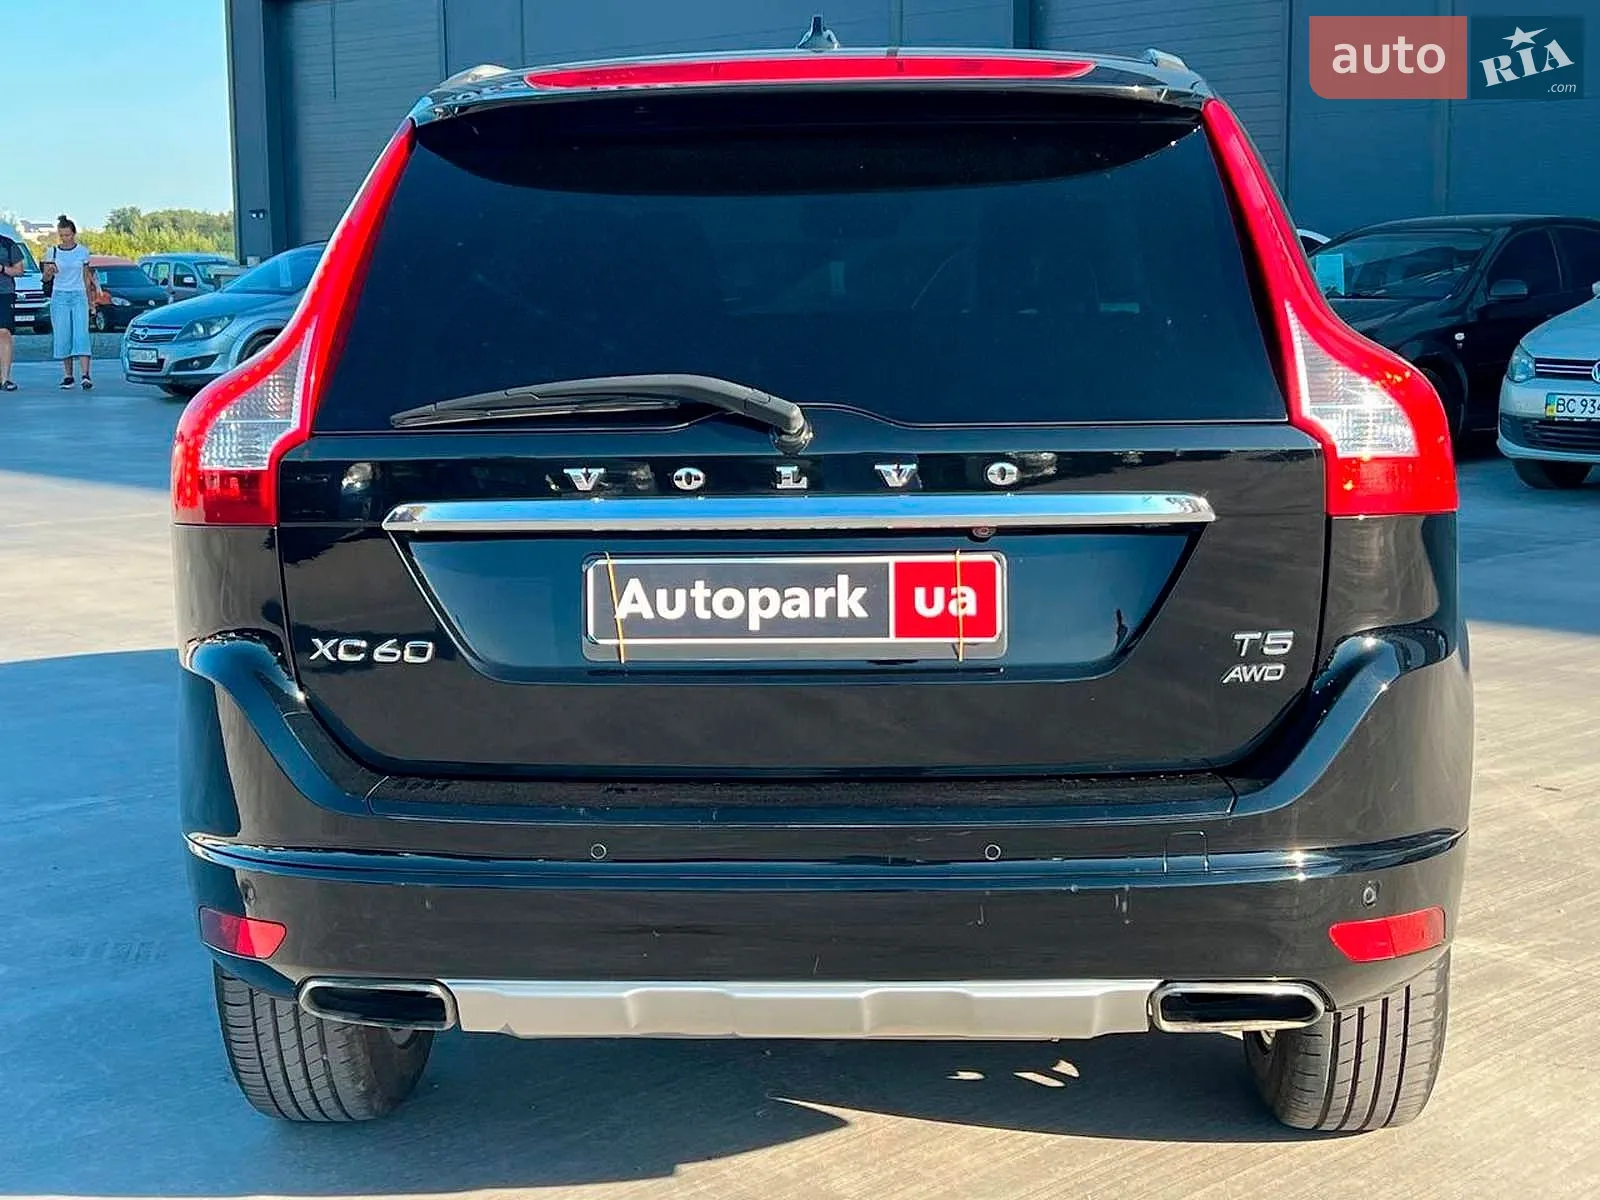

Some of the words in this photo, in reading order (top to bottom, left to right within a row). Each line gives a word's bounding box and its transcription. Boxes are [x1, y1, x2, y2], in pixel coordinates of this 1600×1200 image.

[1556, 398, 1576, 413] BC
[563, 462, 1020, 491] VOLVO
[614, 574, 869, 631] Autopark
[914, 585, 977, 618] ua
[309, 638, 435, 664] XC60
[1234, 631, 1294, 657] T5
[1222, 663, 1286, 684] AWD
